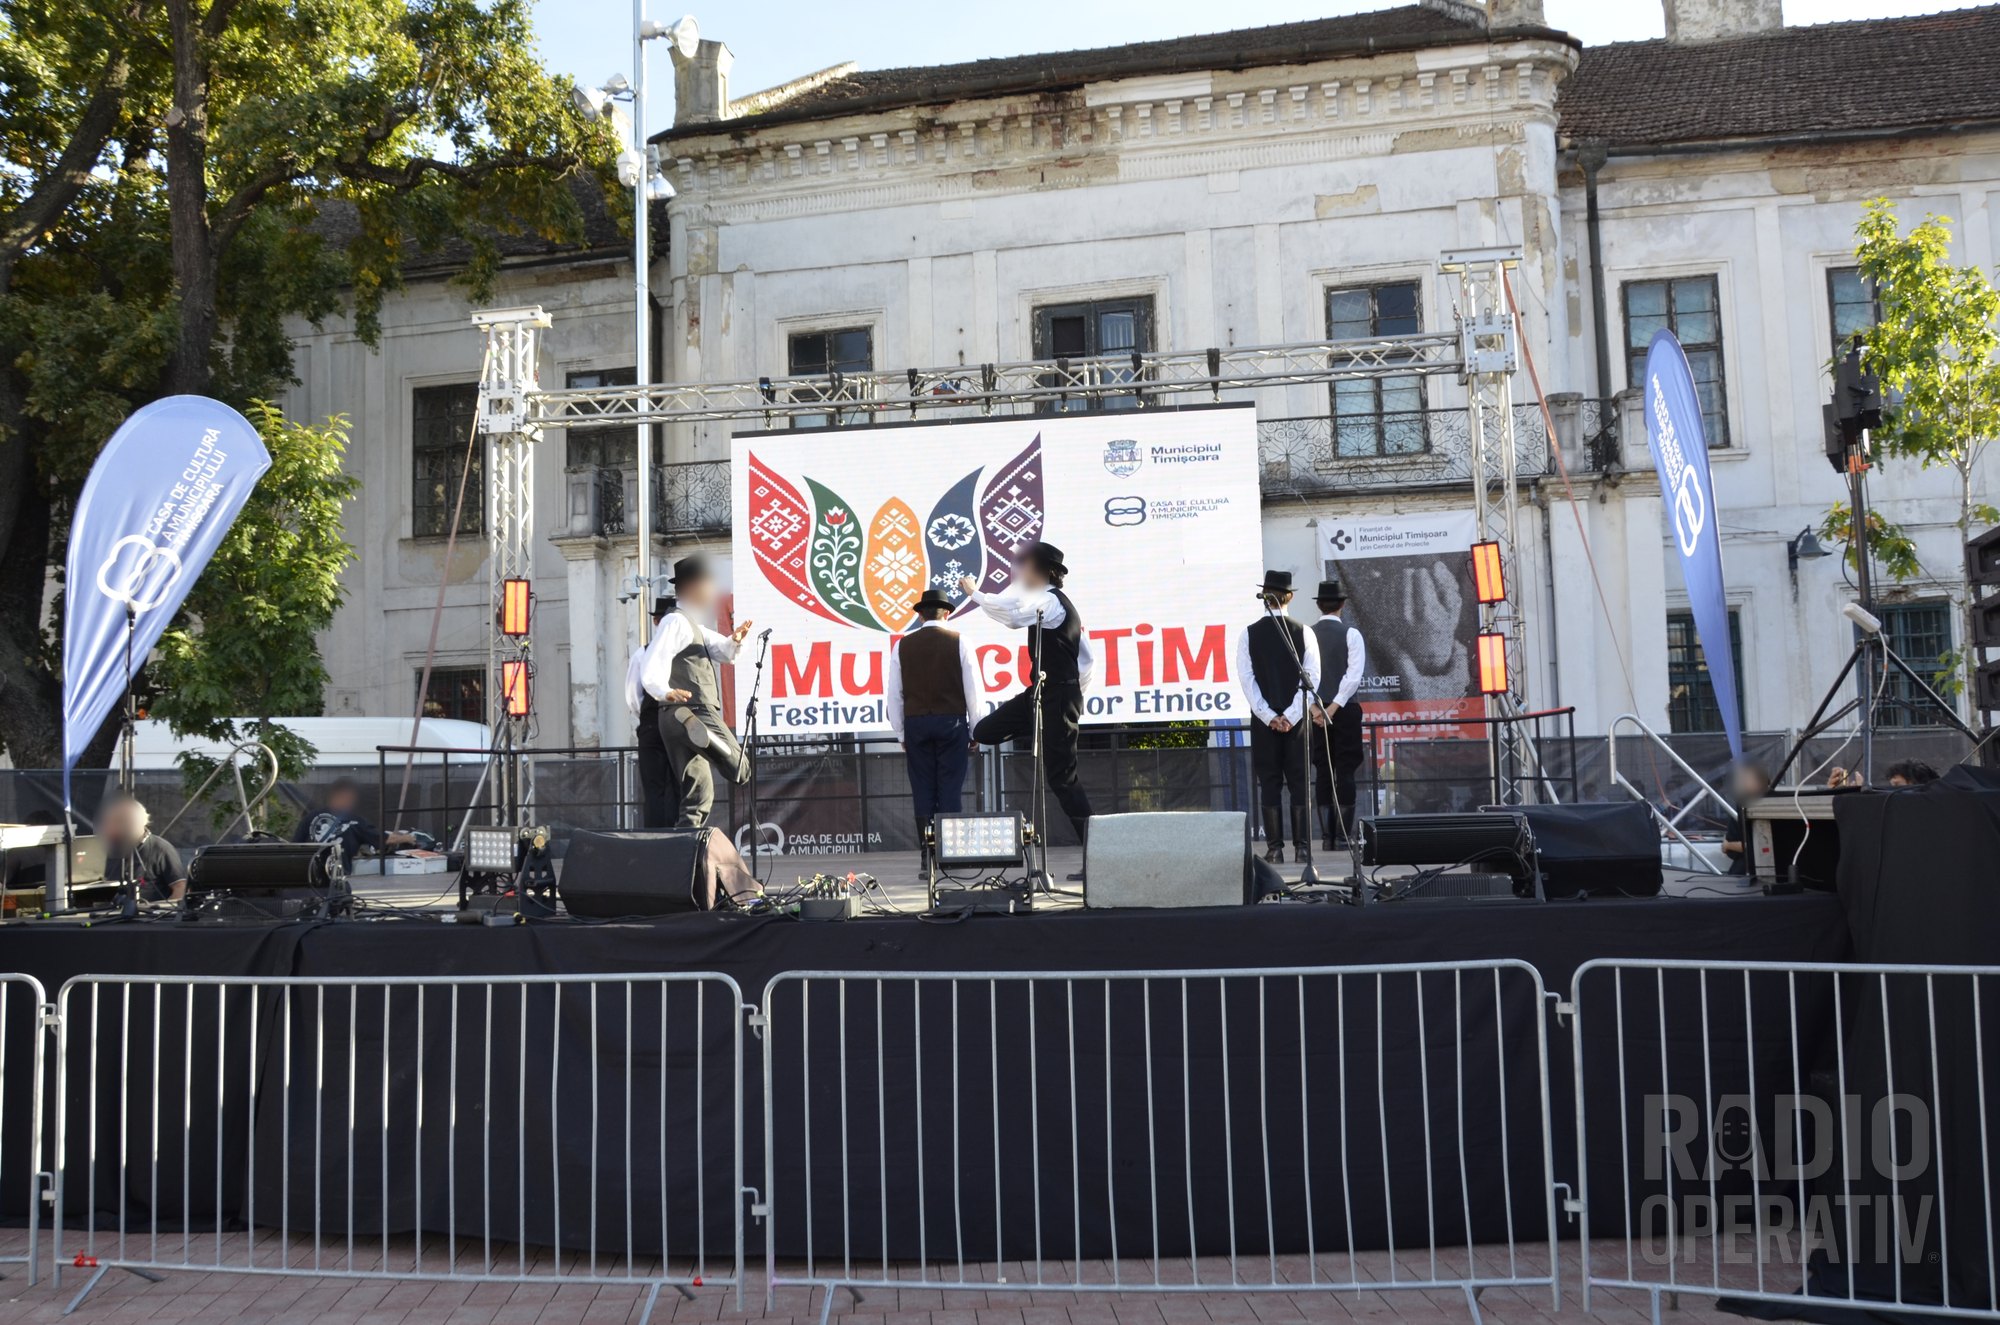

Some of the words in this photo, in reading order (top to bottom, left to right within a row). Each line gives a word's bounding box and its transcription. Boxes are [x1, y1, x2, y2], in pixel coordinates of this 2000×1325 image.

[1151, 443, 1221, 455] Municipiul
[1151, 453, 1219, 464] Timișoara
[167, 449, 228, 533] MUNICIPIULUI
[148, 501, 177, 535] CASA
[170, 482, 189, 500] DE
[1150, 500, 1173, 508] CASA
[1176, 499, 1188, 507] DE
[162, 530, 176, 541] A
[1360, 532, 1403, 543] Municipiul
[770, 699, 889, 727] Festival
[1134, 687, 1232, 714] Etnice
[788, 833, 816, 845] CASA
[819, 833, 833, 845] DE
[789, 845, 797, 856] A
